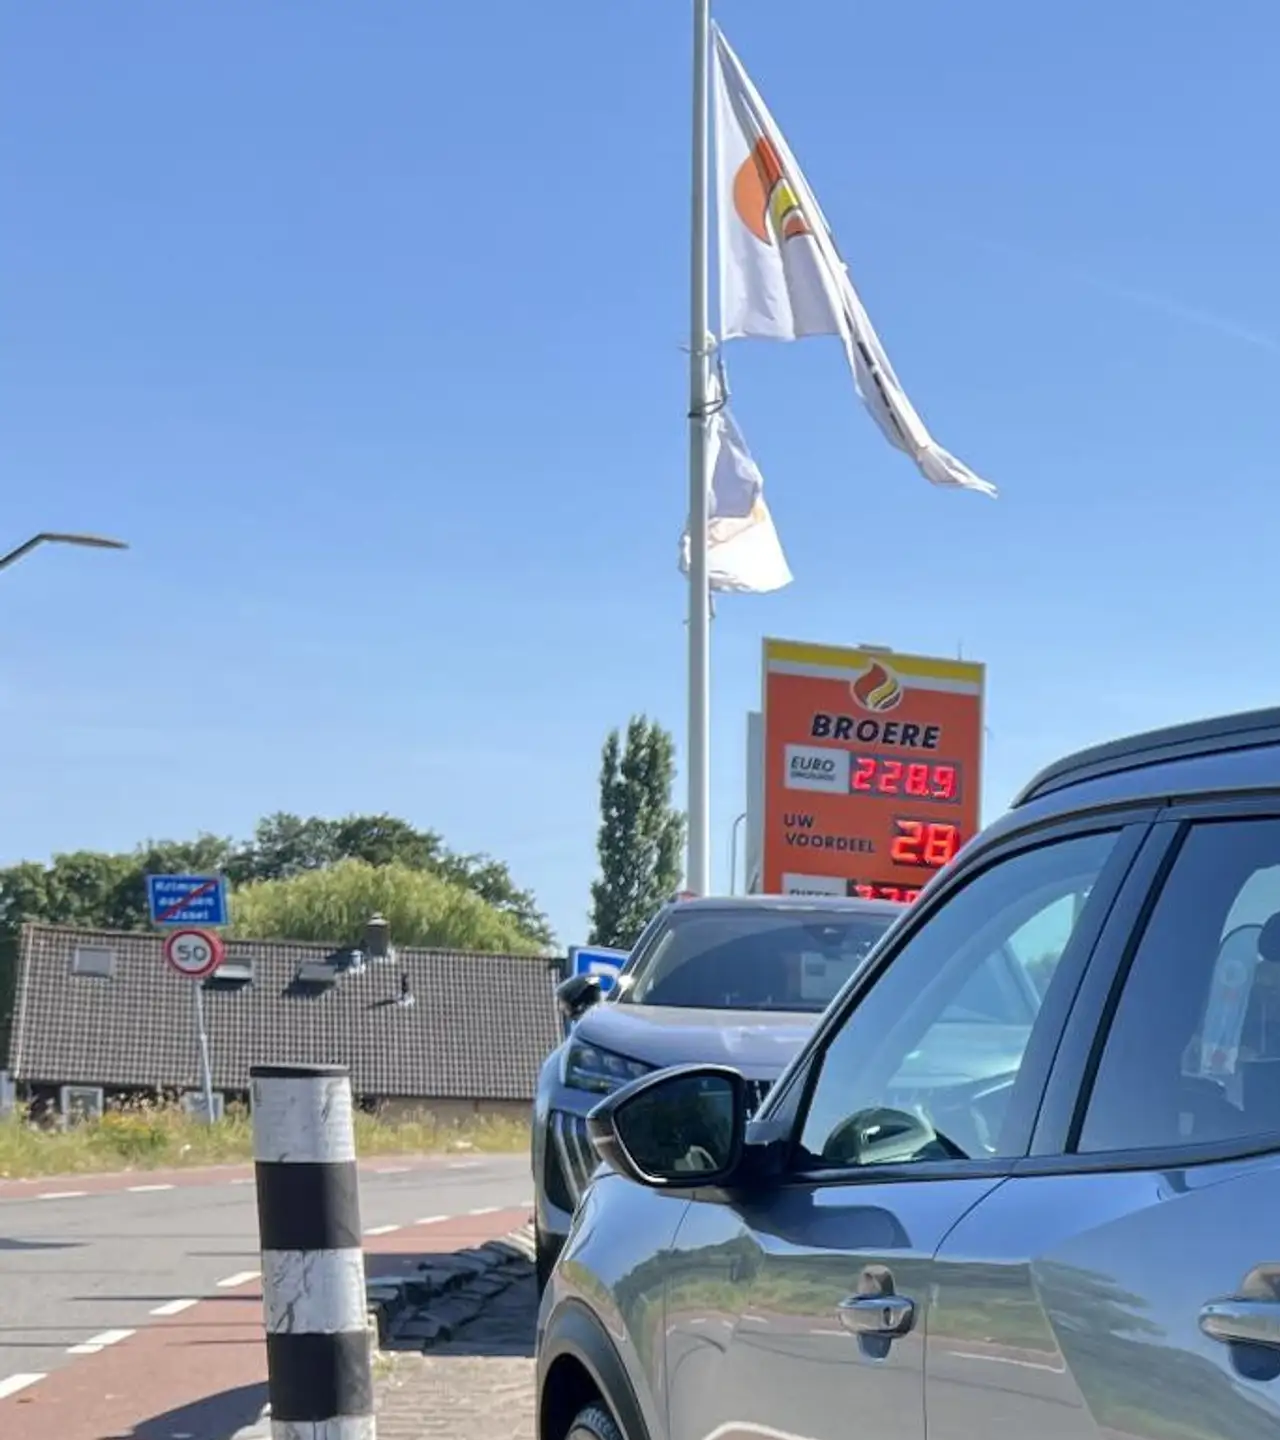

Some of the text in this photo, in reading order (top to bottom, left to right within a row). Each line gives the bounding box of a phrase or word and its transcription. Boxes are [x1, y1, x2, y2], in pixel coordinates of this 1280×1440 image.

[811, 714, 939, 748] BROERE
[790, 756, 836, 773] EURO
[783, 813, 814, 828] UW
[785, 832, 875, 853] VOORDEEL
[890, 819, 960, 866] 28
[177, 944, 207, 961] 50
